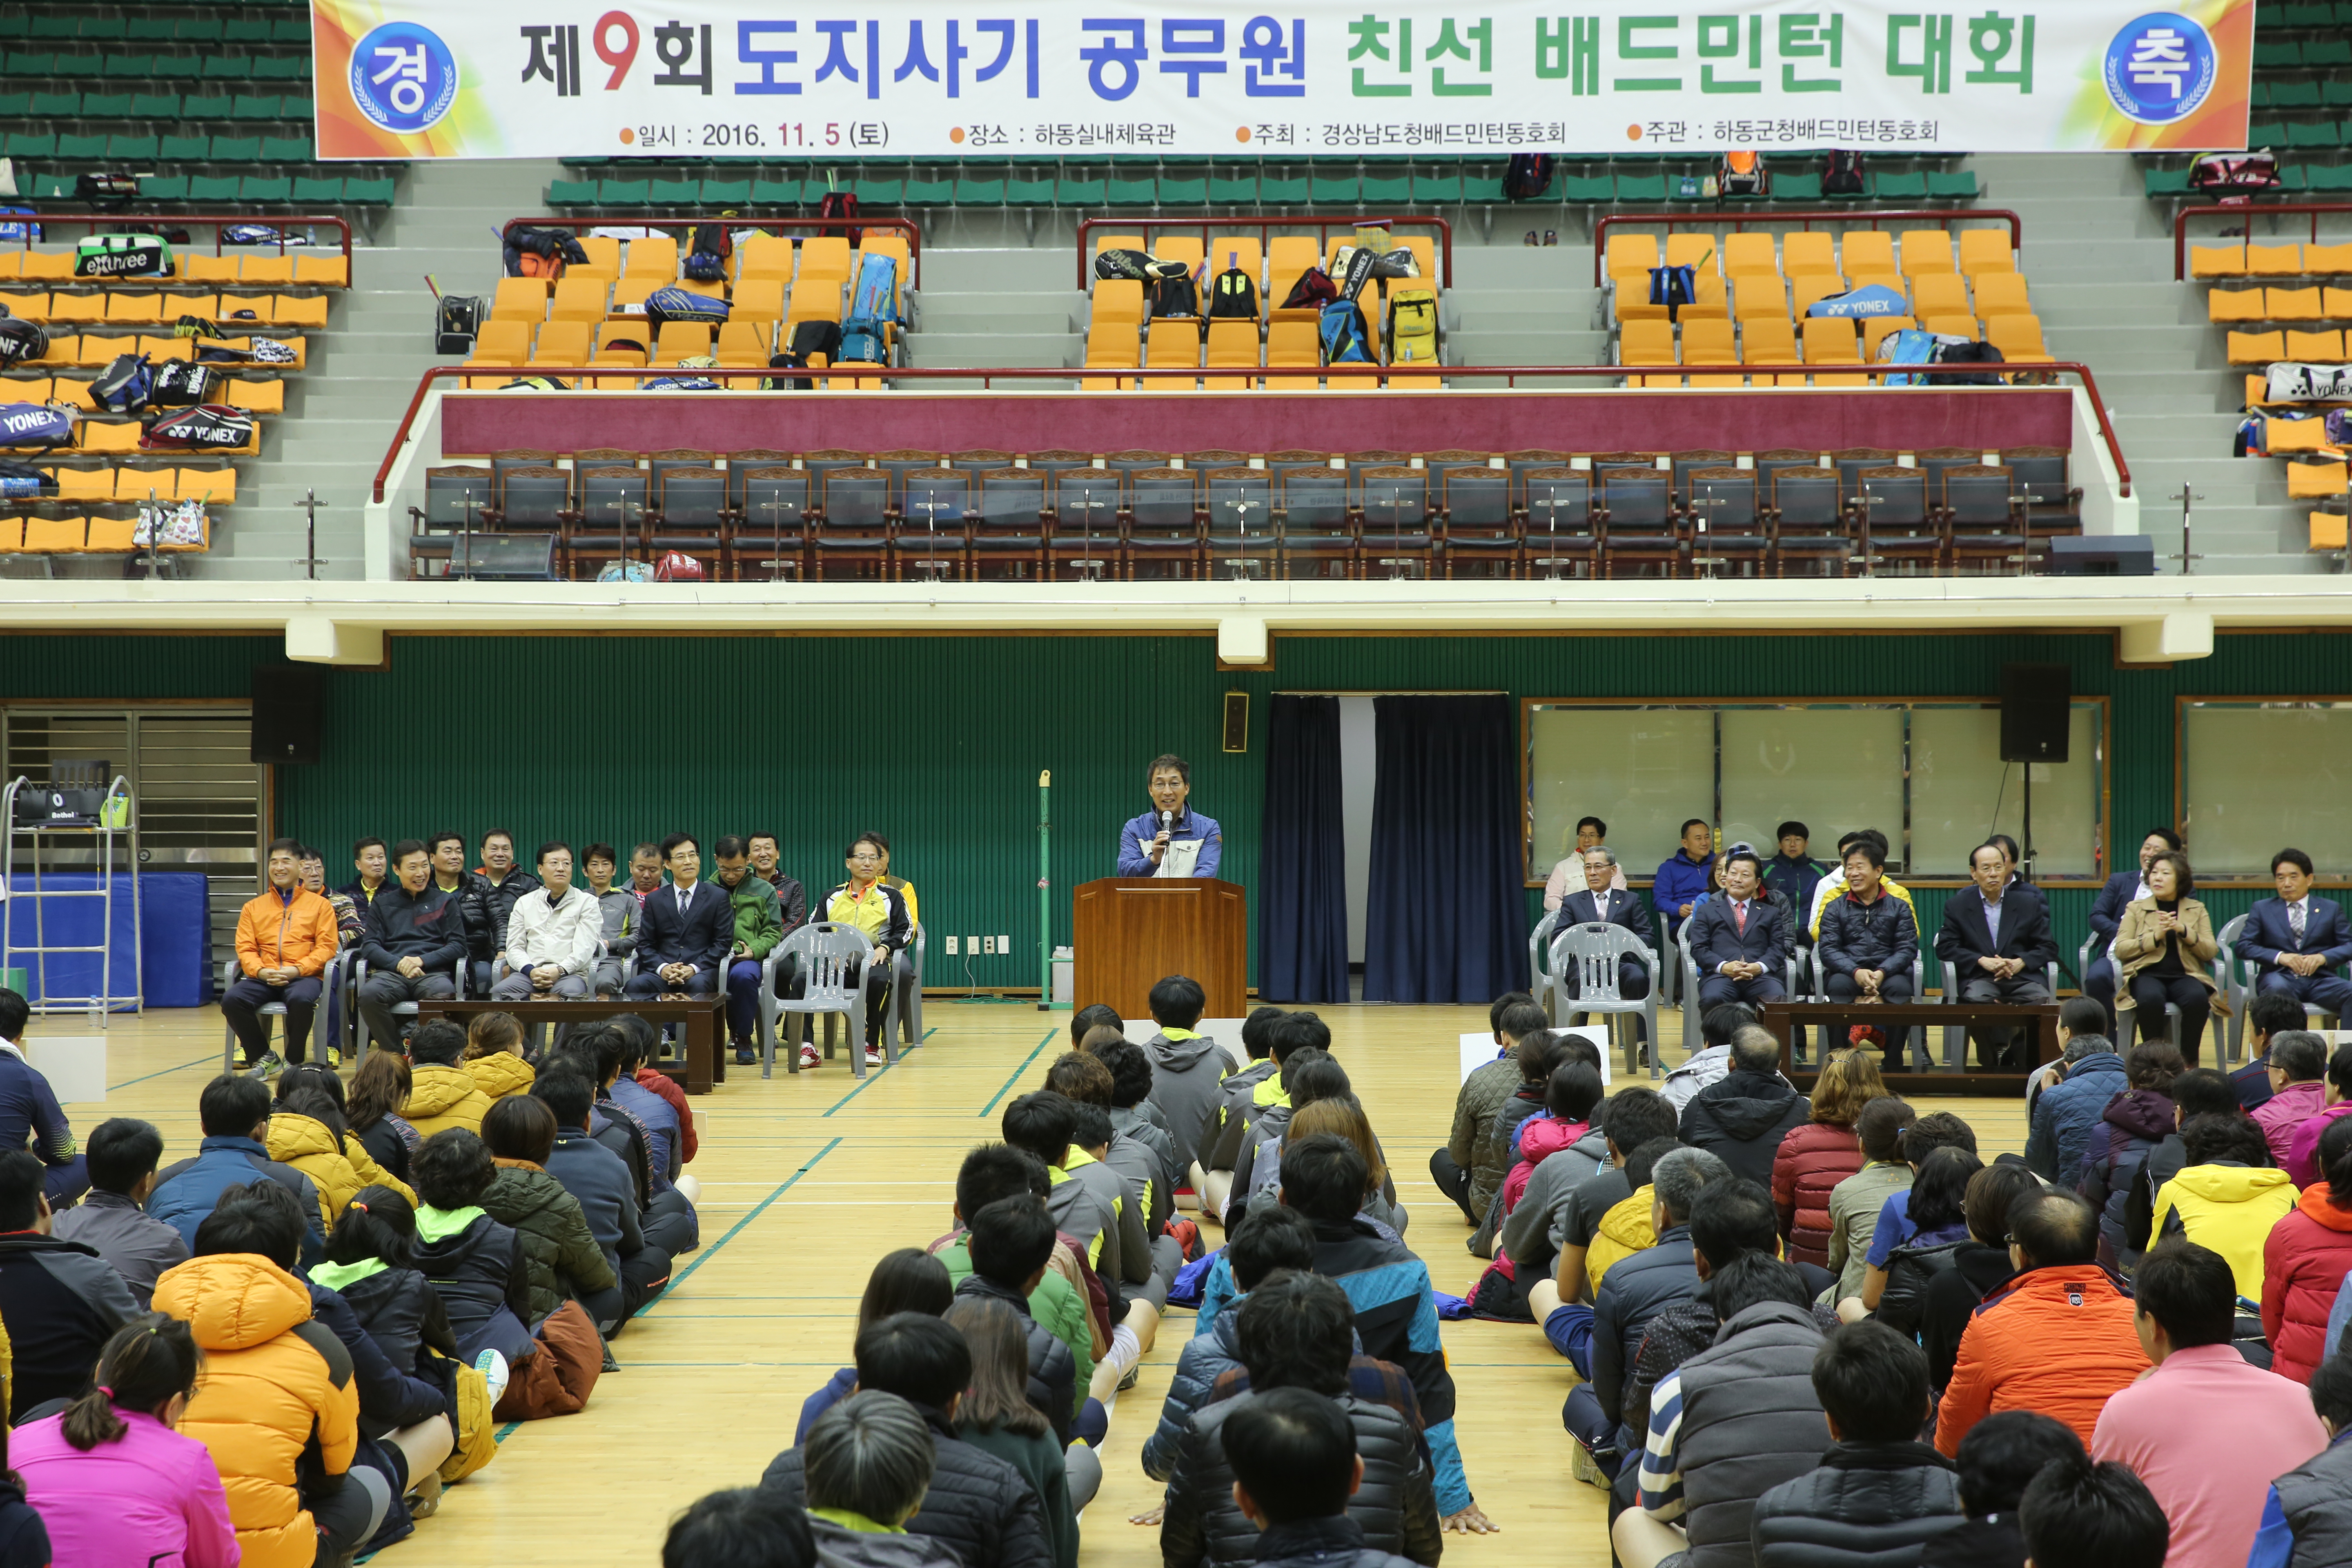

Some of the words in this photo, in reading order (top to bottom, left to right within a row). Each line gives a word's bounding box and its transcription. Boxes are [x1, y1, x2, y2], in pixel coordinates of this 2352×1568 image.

[1080, 16, 1305, 101] 공무원
[1348, 14, 1492, 97] 친선
[1535, 13, 1843, 95] 배드민턴
[1886, 11, 2036, 94] 대회
[2128, 29, 2190, 98] 축
[372, 44, 426, 114] 경
[639, 125, 675, 147] 일시
[703, 124, 766, 146] 2016.
[778, 123, 814, 146] 11.
[826, 123, 840, 145] 5
[849, 122, 888, 148] (토)
[969, 124, 1008, 146] 장소
[1035, 123, 1176, 145] 하동실내체육관
[1255, 124, 1294, 145] 주최
[1323, 122, 1565, 145] 경상남도청배드민턴동호회
[1646, 121, 1686, 143] 주관
[1714, 120, 1938, 144] 하동군청배드민턴동호회
[1349, 253, 1370, 283] YONEX
[1851, 300, 1890, 314] YONEX
[3, 410, 58, 434] YONEX
[194, 425, 237, 443] YONEX
[52, 793, 63, 807] 0
